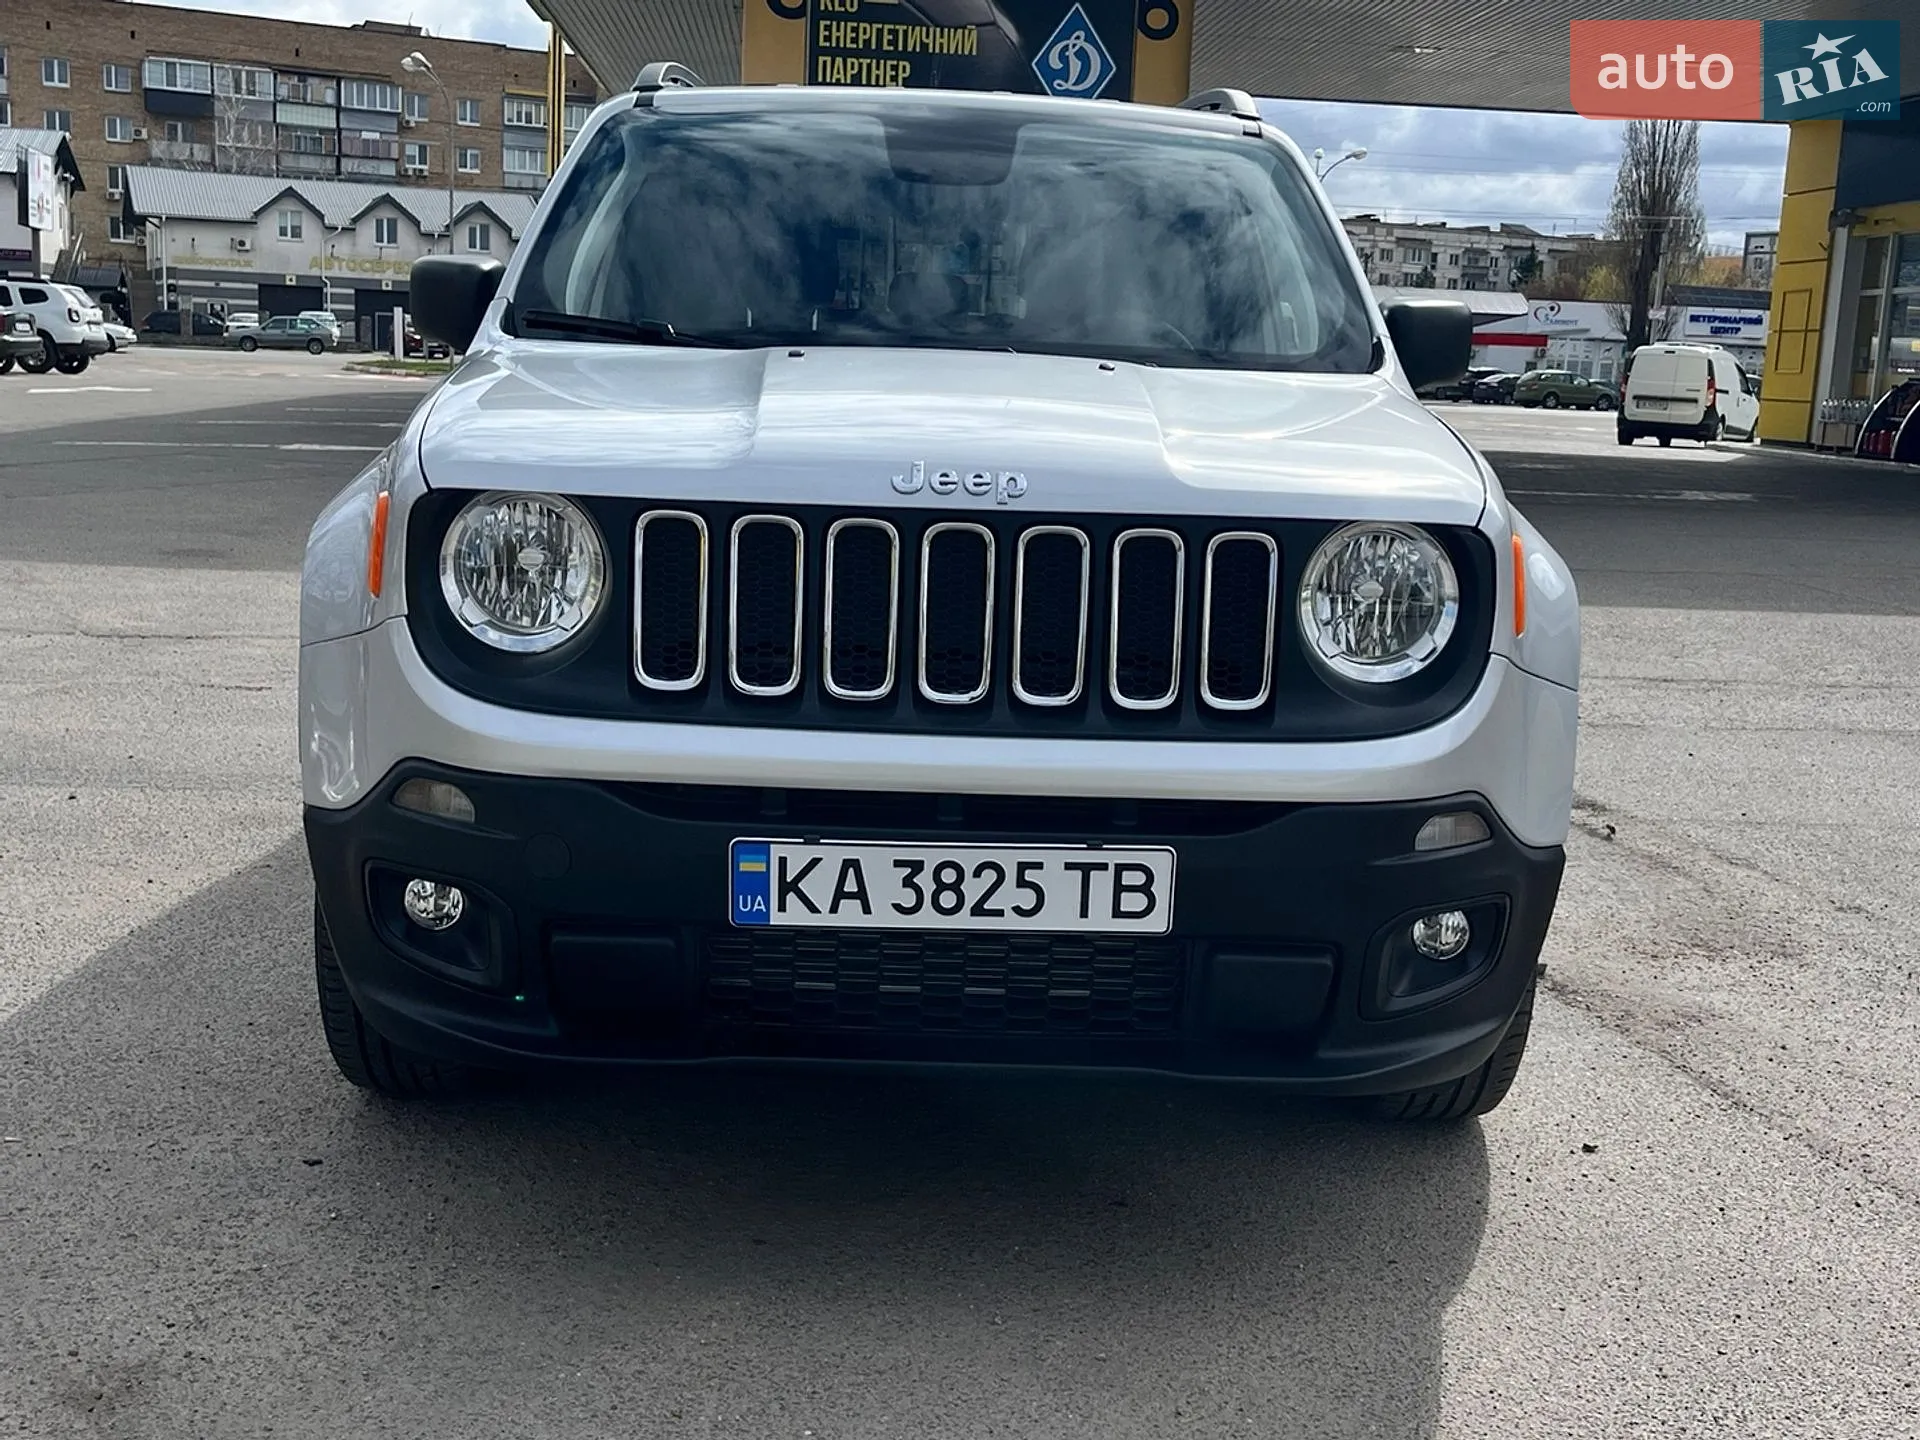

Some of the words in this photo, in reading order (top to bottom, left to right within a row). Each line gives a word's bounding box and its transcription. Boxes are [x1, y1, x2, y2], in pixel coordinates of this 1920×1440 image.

[818, 20, 978, 56] ЕНЕРГЕТИЧНИЙ
[817, 55, 911, 88] ПАРТНЕР
[891, 460, 1028, 505] Jeep
[738, 895, 767, 913] UA
[776, 856, 872, 915] KA
[891, 859, 1046, 919] 3825
[1063, 861, 1157, 920] TB
